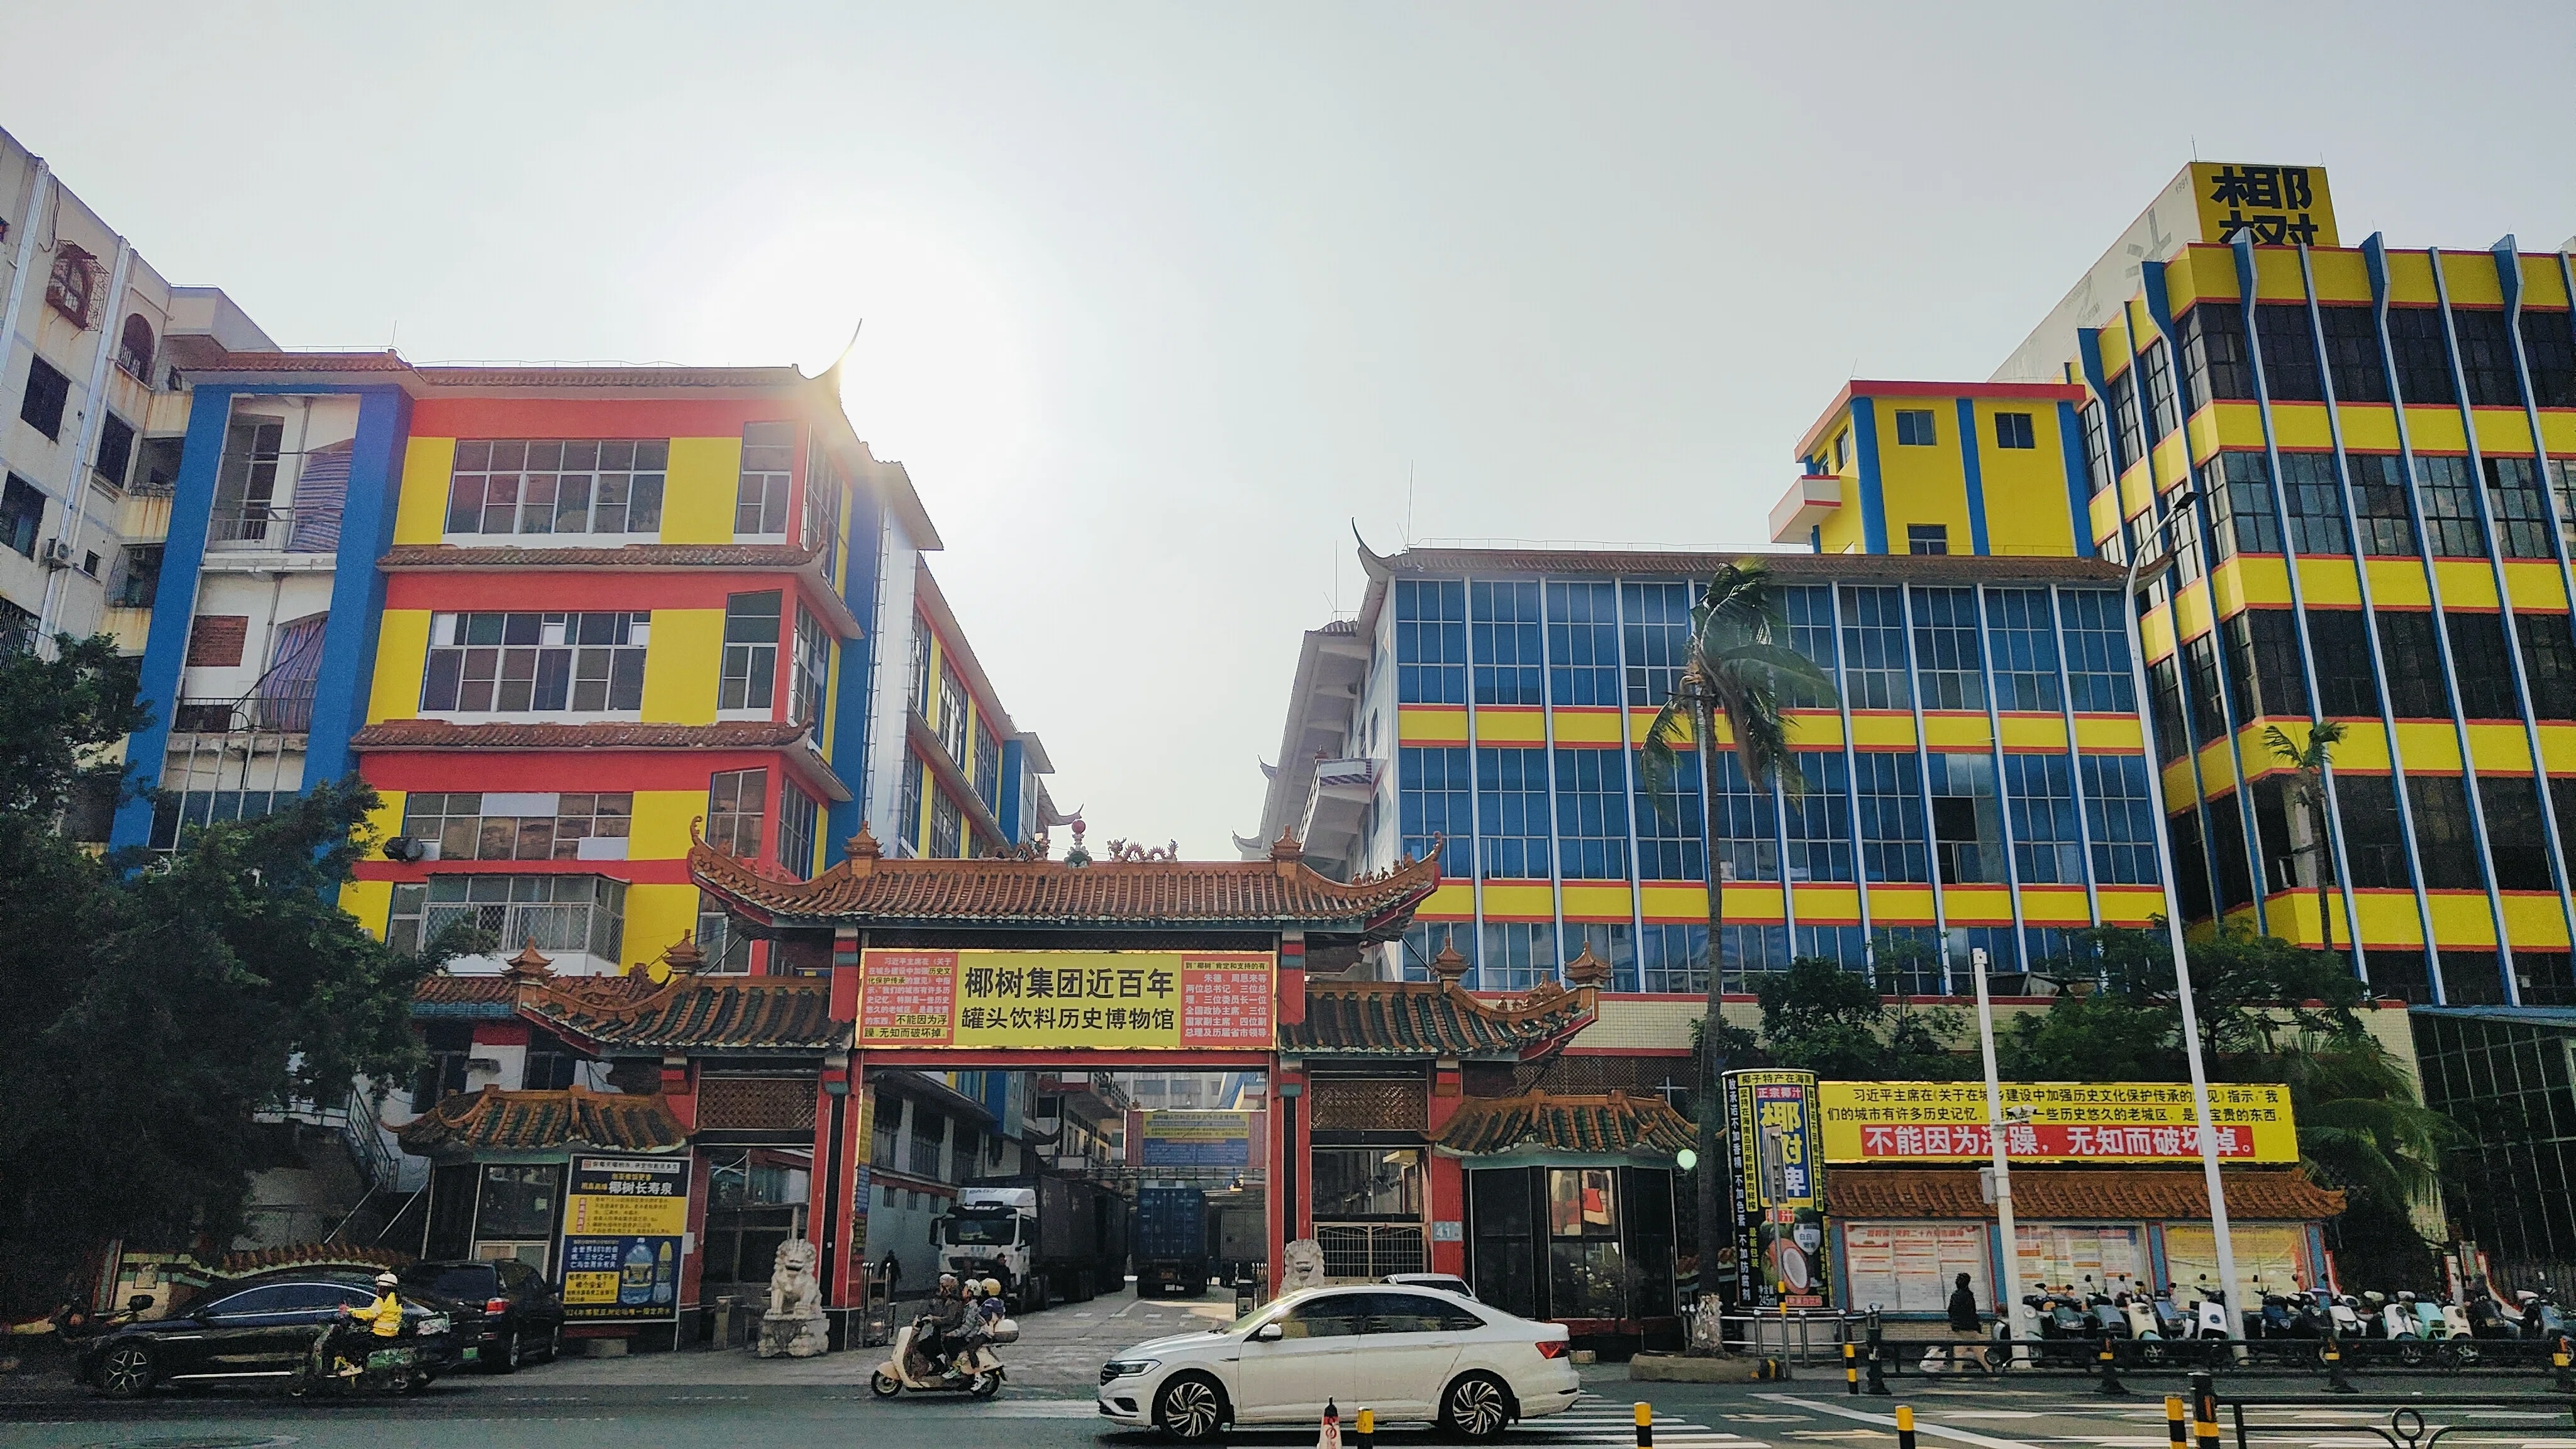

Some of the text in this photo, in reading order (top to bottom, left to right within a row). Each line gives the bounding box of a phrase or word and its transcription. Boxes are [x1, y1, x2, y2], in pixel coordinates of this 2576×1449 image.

[965, 967, 1174, 999] 椰树集团近百年
[961, 1006, 1174, 1030] 罐头饮料历史博物馆
[1757, 1087, 1802, 1099] 正宗椰汁
[608, 1180, 673, 1195] 椰树长寿泉
[1436, 1227, 1450, 1237] 41
